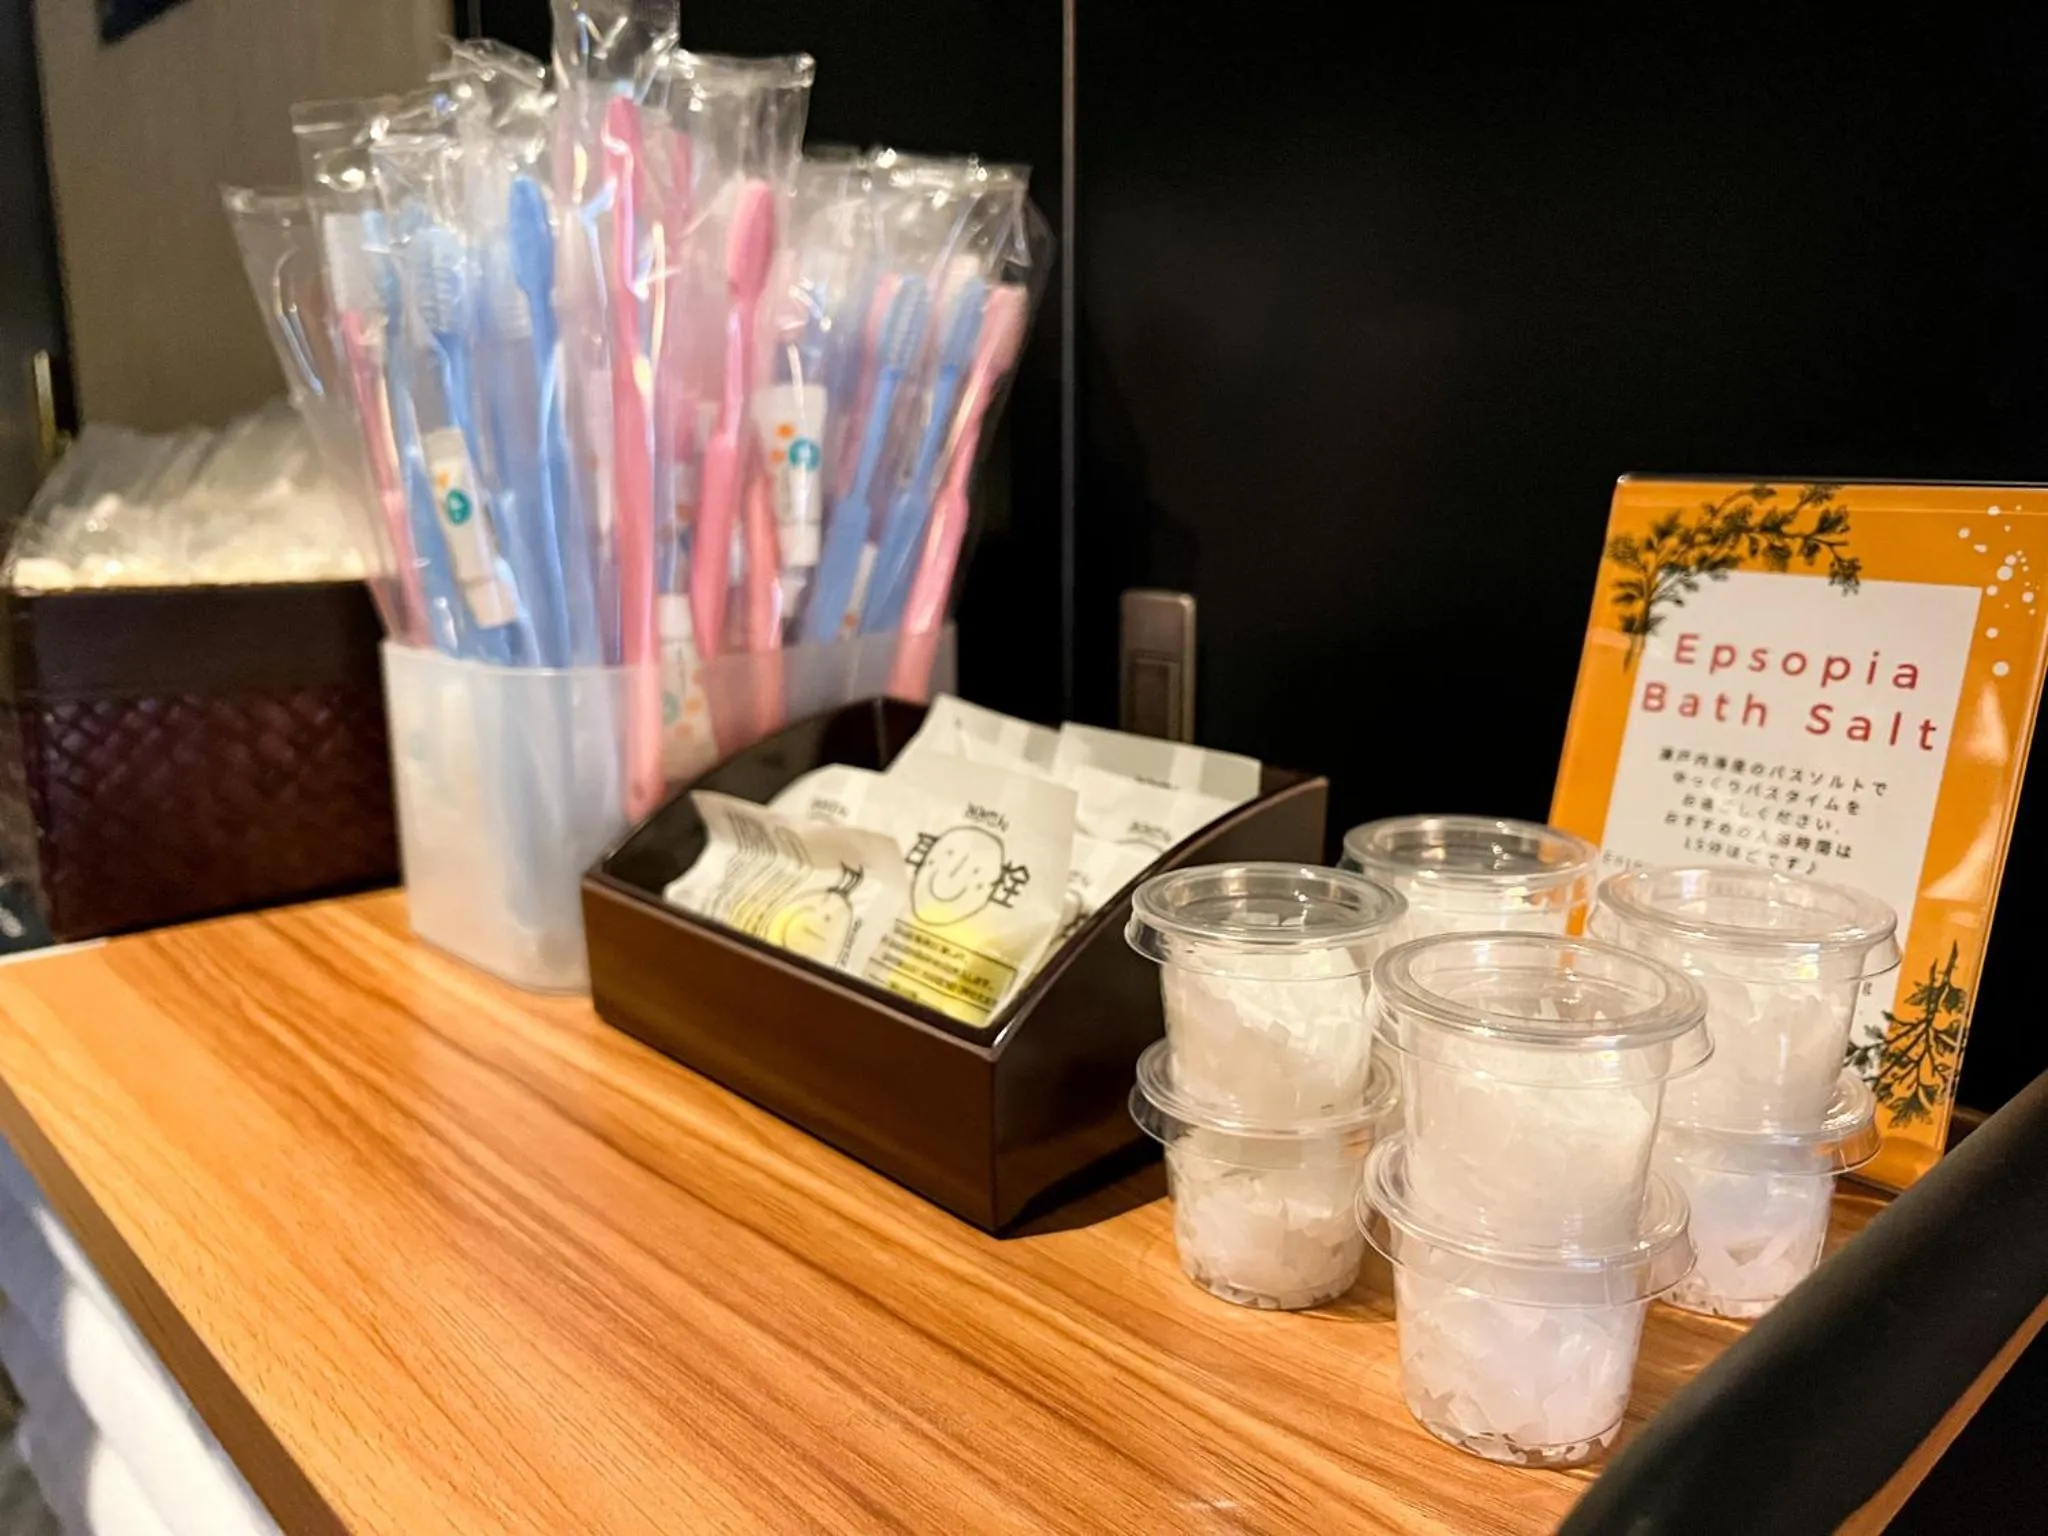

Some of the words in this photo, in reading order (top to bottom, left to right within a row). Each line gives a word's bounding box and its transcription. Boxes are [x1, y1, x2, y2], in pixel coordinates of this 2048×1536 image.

[1674, 633, 1919, 690] Epsopia
[1641, 681, 1768, 728] Bath
[1805, 703, 1937, 751] Salt
